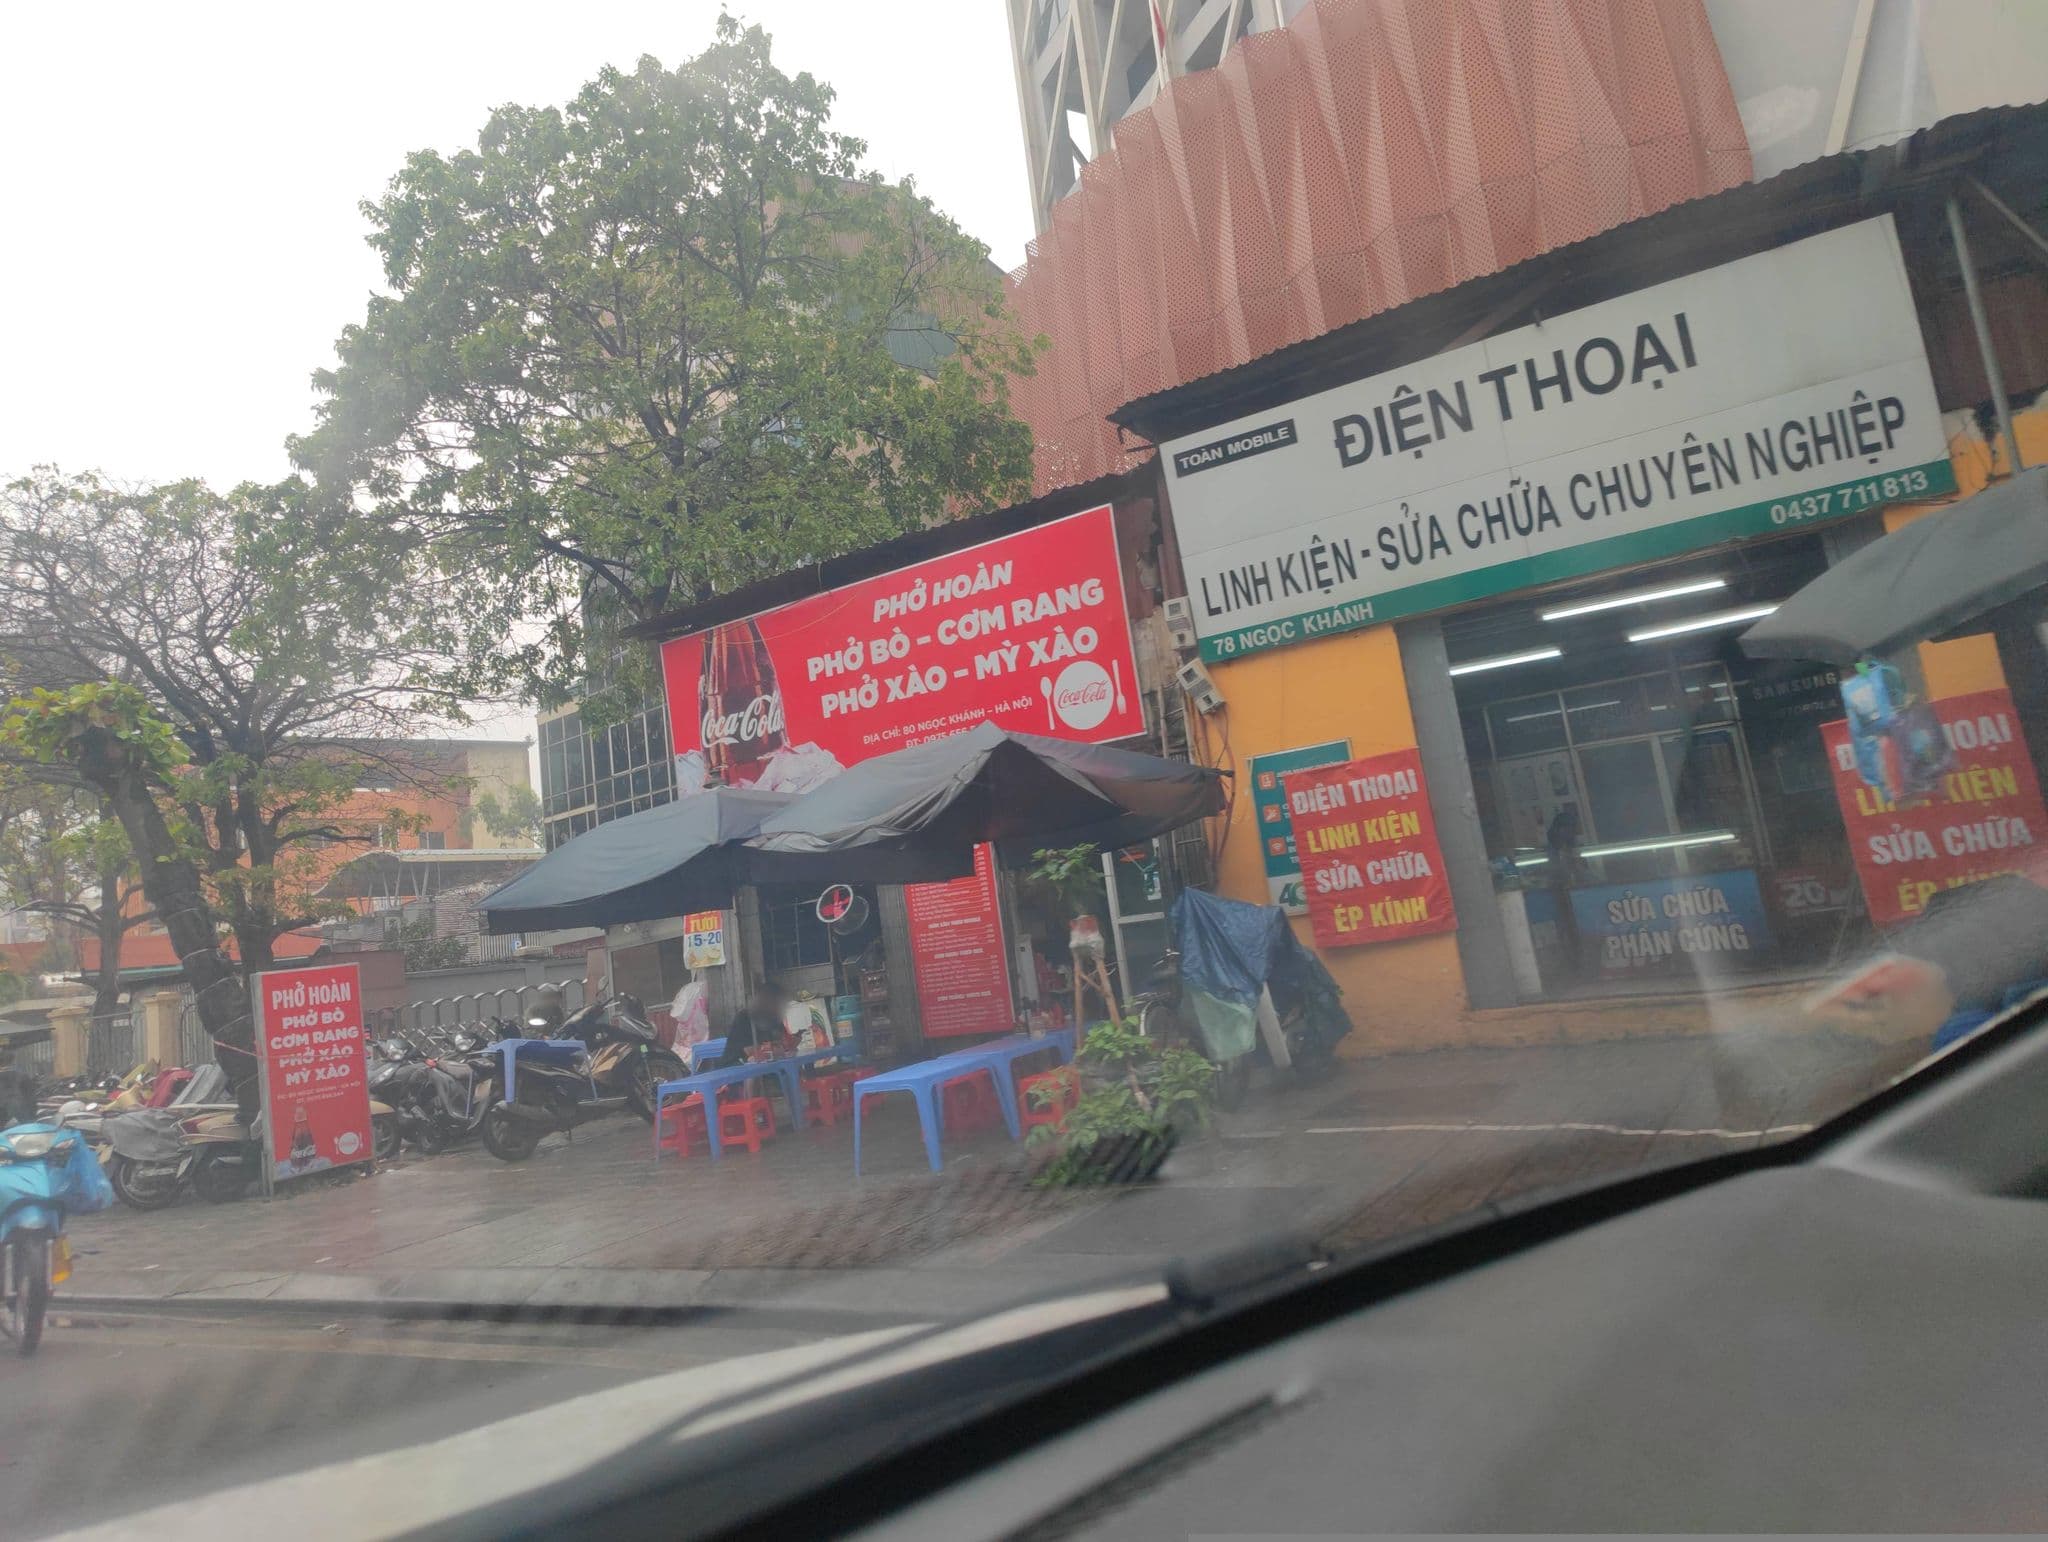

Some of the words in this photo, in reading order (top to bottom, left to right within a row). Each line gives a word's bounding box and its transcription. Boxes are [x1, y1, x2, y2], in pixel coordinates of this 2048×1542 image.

[1332, 380, 1474, 468] ĐIỆN
[1478, 312, 1697, 421] THOẠI
[1178, 447, 1223, 470] TOÀN
[1227, 426, 1291, 456] MOBILE
[1200, 563, 1274, 617] LINH
[1281, 533, 1357, 595] KIỆN
[1377, 502, 1453, 572] SỬA
[1457, 477, 1562, 550] CHỮA
[1569, 431, 1741, 522] CHUYÊN
[1745, 389, 1906, 480] NGHIỆP
[1770, 492, 1833, 525] 0437
[872, 581, 927, 623] PHỞ
[932, 560, 1014, 604] HOÀN
[807, 636, 865, 682] PHỞ
[870, 627, 911, 666] BÒ
[937, 604, 1003, 646] CƠM
[1011, 578, 1105, 627] RANG
[1213, 639, 1236, 657] 78
[1239, 621, 1297, 652] NGỌC
[1303, 601, 1375, 635] KHÁNH
[821, 673, 879, 718] PHỞ
[886, 665, 948, 703] XÀO
[974, 634, 1024, 681] MỲ
[1029, 626, 1098, 667] XÀO
[701, 690, 785, 748] Coca-Cola
[863, 734, 881, 746] ĐỊA
[902, 723, 916, 735] 80
[917, 716, 947, 731] NGỌC
[949, 706, 986, 725] KHÁNH
[995, 699, 1011, 714] HÀ
[1012, 696, 1033, 710] NỘI
[1292, 782, 1347, 815] ĐIỆN
[1348, 768, 1419, 804] THOẠI
[1306, 822, 1361, 854] LINH
[1364, 810, 1421, 844] KIỆN
[1868, 824, 1937, 866] SỬA
[1941, 816, 2033, 857] CHỮA
[1314, 859, 1364, 894] SỬA
[1366, 850, 1433, 885] CHỮA
[1333, 902, 1364, 932] ÉP
[1370, 895, 1429, 928] KÍNH
[272, 981, 305, 1010] PHỞ
[308, 978, 352, 1006] HOÀN
[270, 1033, 310, 1049] CƠM
[312, 1026, 359, 1044] RANG
[282, 1009, 318, 1029] PHỞ
[315, 1063, 350, 1081] XÀO
